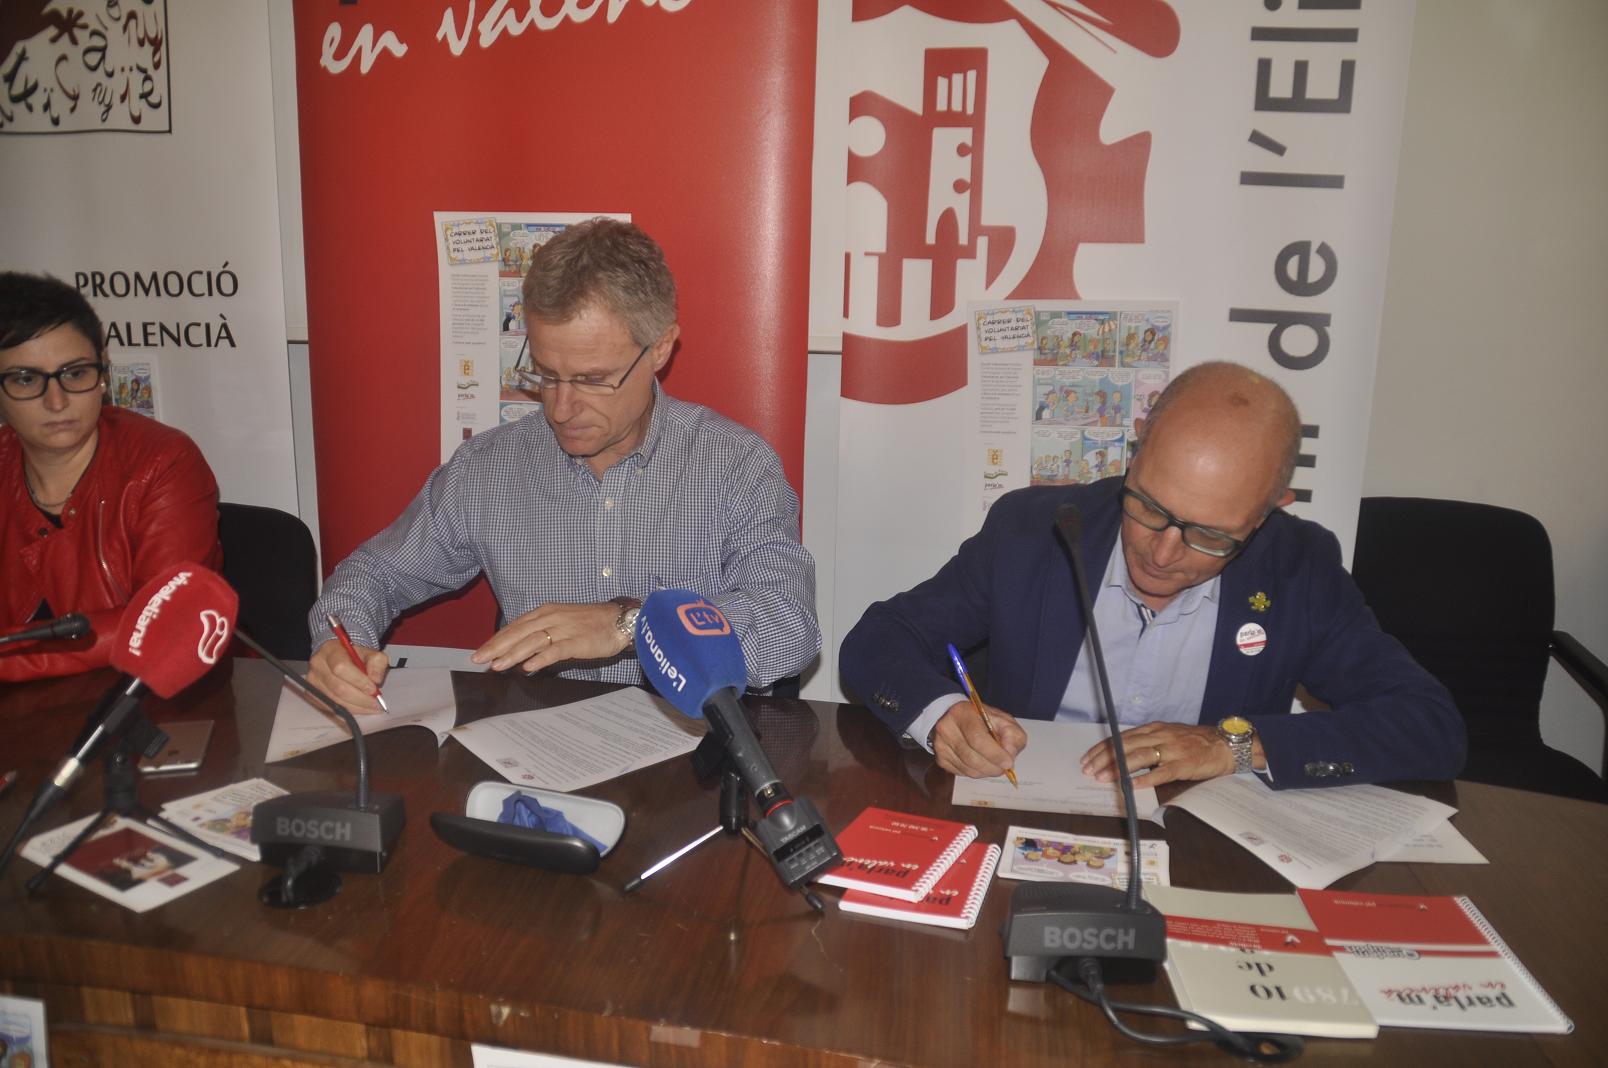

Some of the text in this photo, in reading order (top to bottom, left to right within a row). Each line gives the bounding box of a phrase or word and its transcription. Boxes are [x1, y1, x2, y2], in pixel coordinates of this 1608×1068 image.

[319, 21, 409, 75] en
[74, 260, 240, 298] PROMOCIÓ
[1228, 240, 1339, 371] de
[101, 313, 237, 348] ALENCIÀ
[276, 815, 352, 842] BOSCH
[1043, 926, 1137, 952] BOSCH
[1236, 960, 1275, 977] de
